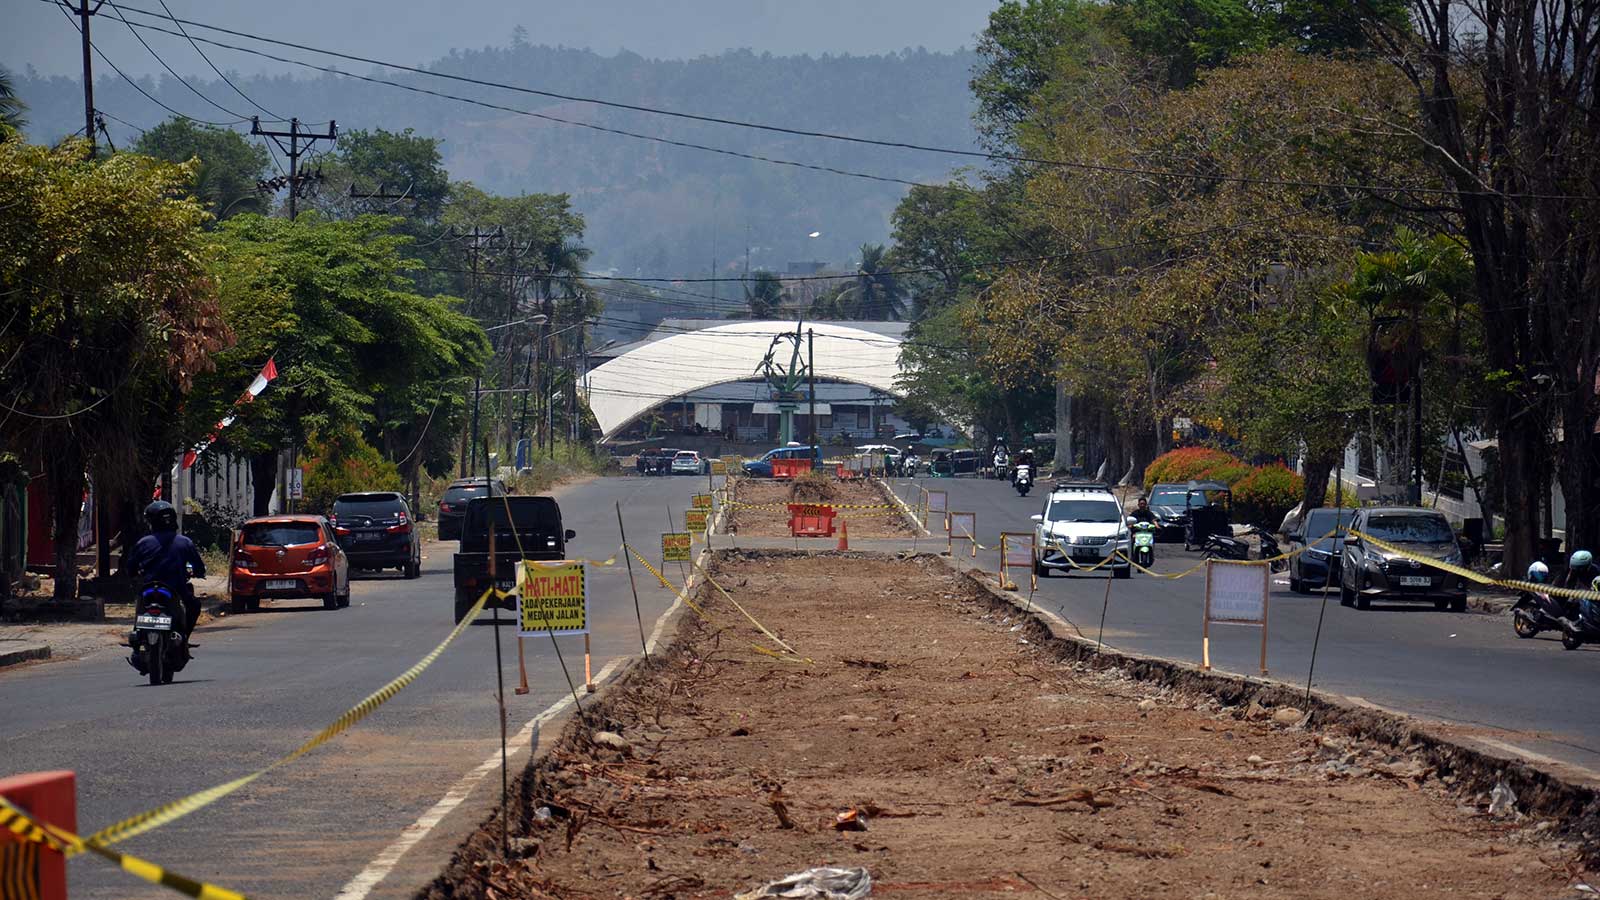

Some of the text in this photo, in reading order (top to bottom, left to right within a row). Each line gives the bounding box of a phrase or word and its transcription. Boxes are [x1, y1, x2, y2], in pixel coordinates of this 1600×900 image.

[525, 576, 579, 597] HATI-HATI
[525, 597, 580, 609] ADA PEKERJAAN
[528, 609, 579, 620] MEDIAN JALAN
